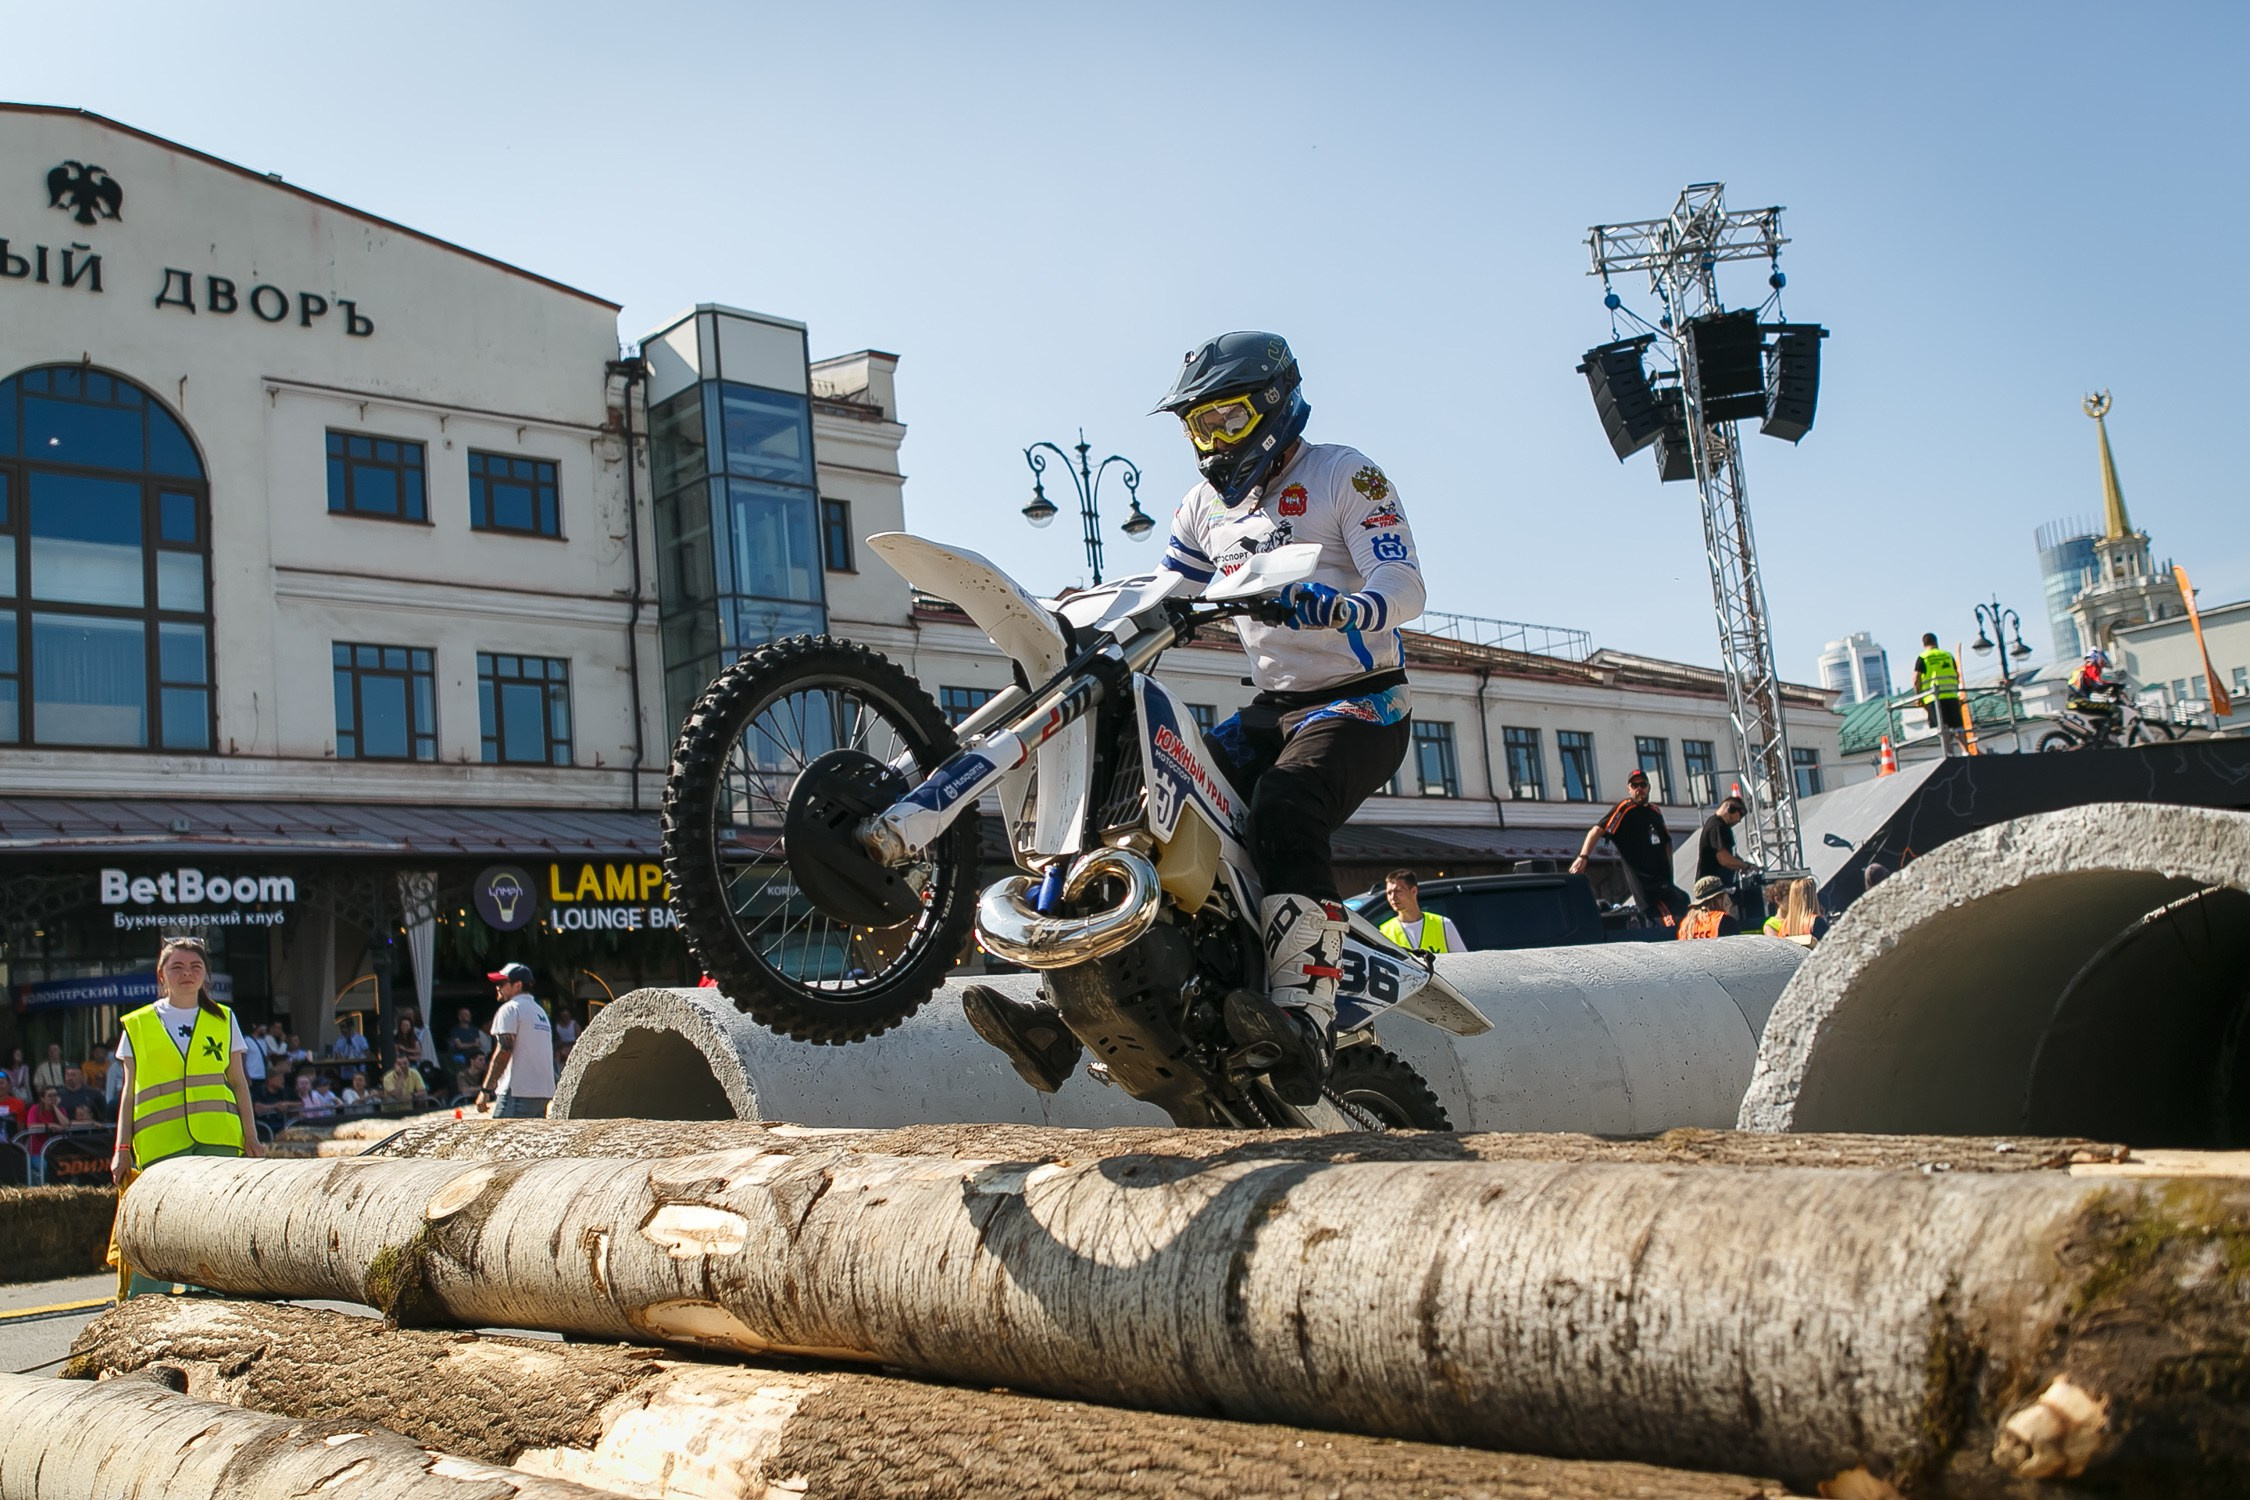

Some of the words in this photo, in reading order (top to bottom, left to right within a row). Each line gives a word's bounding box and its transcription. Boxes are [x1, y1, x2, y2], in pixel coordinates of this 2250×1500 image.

[155, 267, 375, 338] ДВОРЪ
[952, 762, 985, 788] Husqvarna
[1155, 749, 1191, 784] МОТОСПОРТ
[1155, 724, 1207, 788] ЮЖНЫЙ
[1205, 776, 1231, 817] УРАЛ
[101, 868, 295, 904] BetBoom
[114, 910, 240, 931] Букмекерский
[245, 909, 285, 927] клуб
[552, 908, 643, 930] LOUNGE
[651, 908, 679, 929] BA
[123, 983, 160, 999] ЦЕНТ
[1335, 948, 1401, 1004] 36
